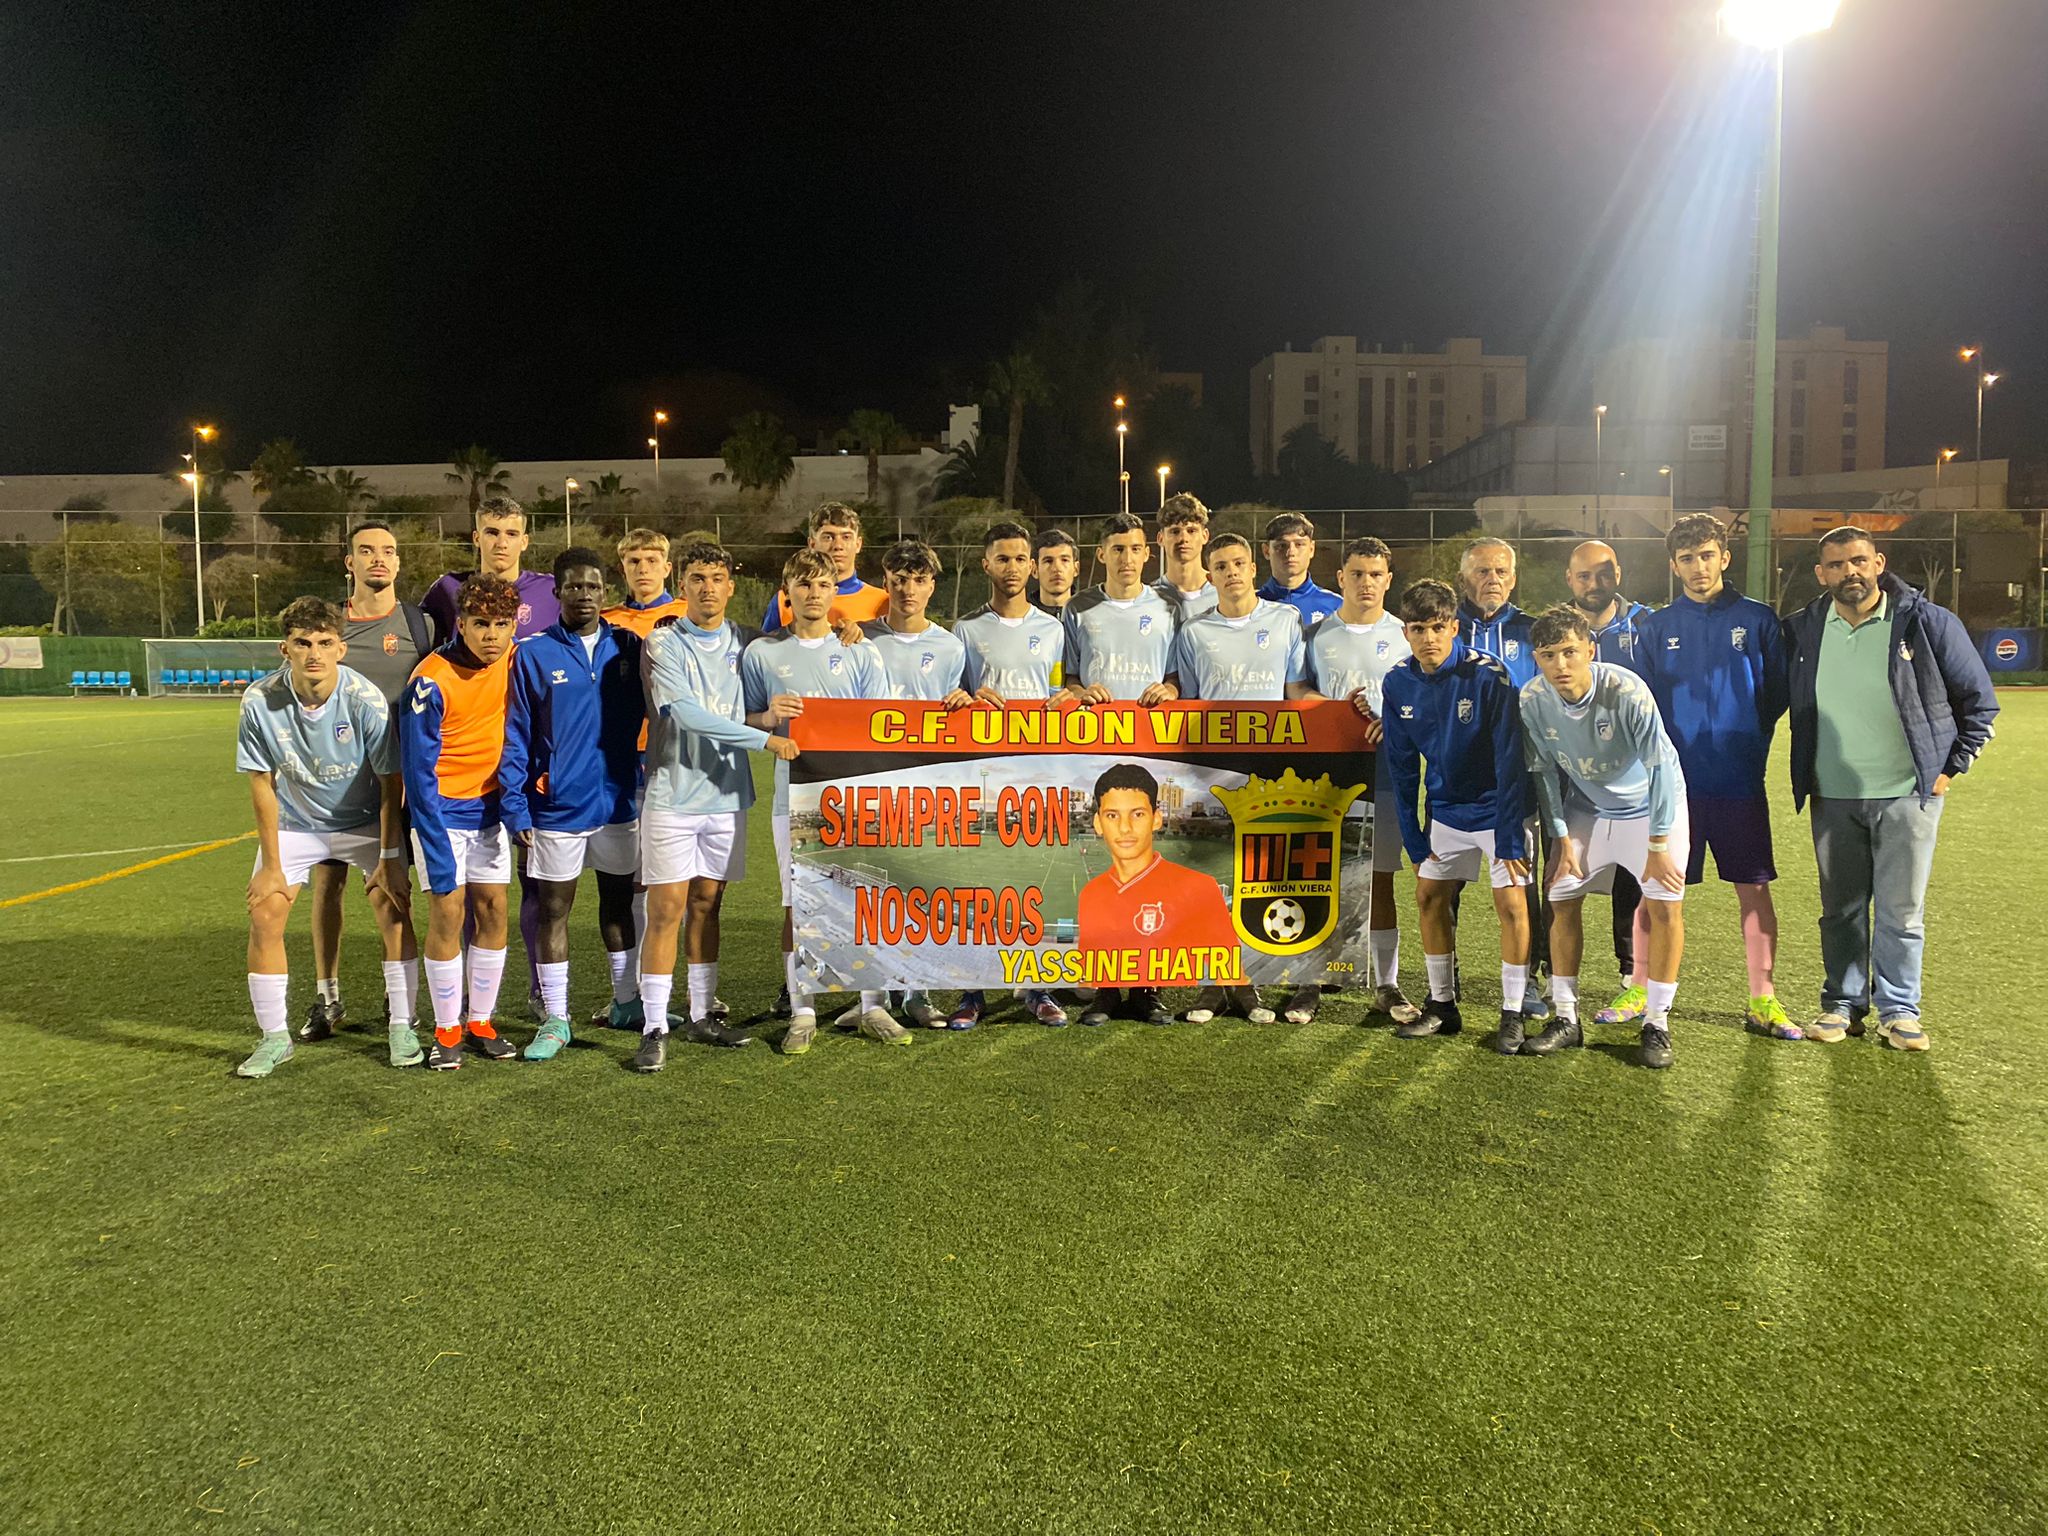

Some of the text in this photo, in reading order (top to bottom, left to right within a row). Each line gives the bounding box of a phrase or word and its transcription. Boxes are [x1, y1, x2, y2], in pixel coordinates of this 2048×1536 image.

[869, 709, 956, 745] C.F.
[1149, 710, 1308, 745] VIERA
[819, 785, 1070, 848] SIEMPRE CON
[1240, 883, 1332, 894] C.F. UNIÓN VIERA
[854, 885, 1045, 946] NOSOTROS
[998, 946, 1242, 984] YASSINE HATRI
[1326, 961, 1354, 972] 2024
